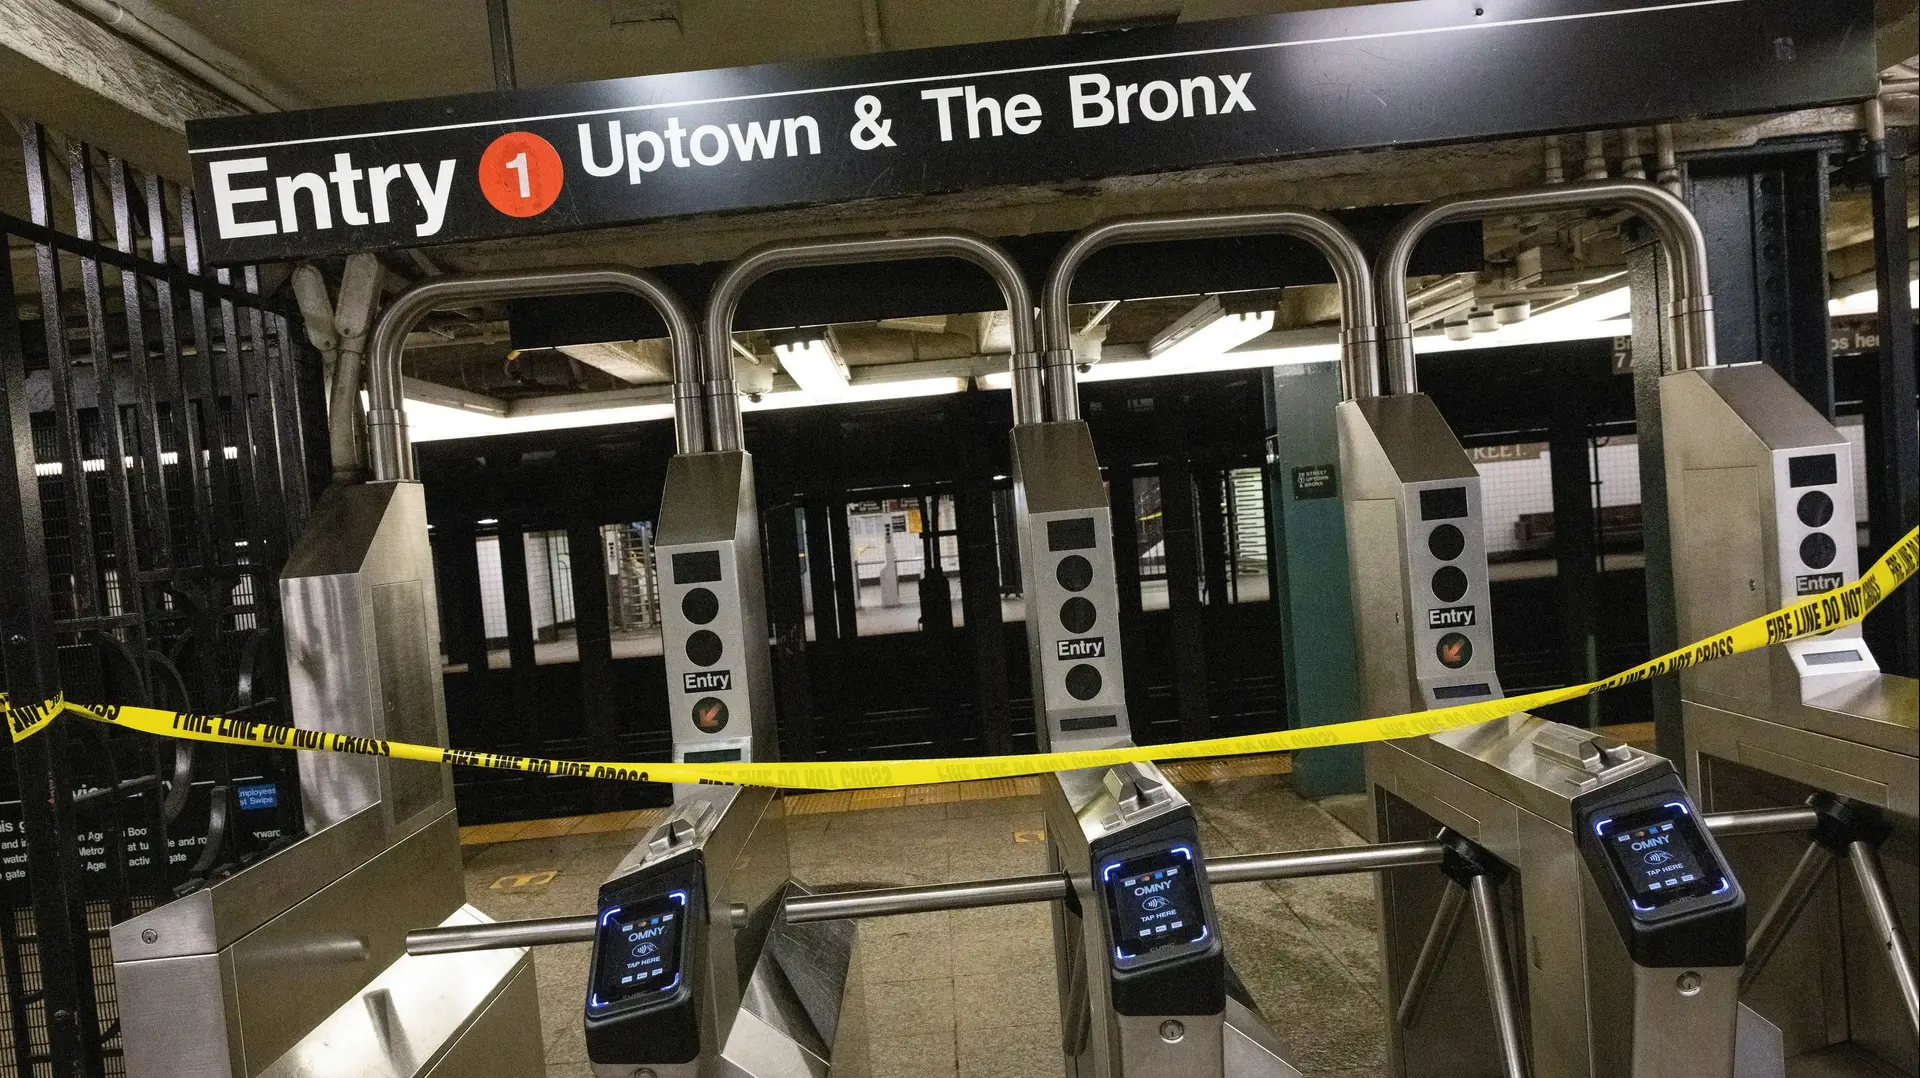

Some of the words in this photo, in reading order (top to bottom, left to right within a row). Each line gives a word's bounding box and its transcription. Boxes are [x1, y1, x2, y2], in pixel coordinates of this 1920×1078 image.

[209, 151, 457, 239] Entry
[505, 152, 532, 198] 1
[577, 114, 822, 185] Uptown
[849, 94, 898, 151] &
[921, 86, 1043, 142] The
[1068, 72, 1257, 129] Bronx
[1797, 574, 1841, 591] Entry
[1430, 609, 1473, 625] Entry
[1766, 613, 1792, 645] FIRE
[1794, 602, 1822, 635] LINE
[1822, 596, 1841, 627] DO
[1840, 586, 1864, 621] NOT
[1059, 640, 1102, 657] Entry
[1649, 662, 1665, 677] DO
[1668, 653, 1692, 673] NOT
[1695, 635, 1734, 664] CROSS
[685, 673, 729, 690] Entry
[172, 711, 213, 735] FIRE
[217, 716, 258, 742] LINE
[262, 724, 291, 745] DO
[293, 728, 327, 750] NOT
[332, 734, 390, 757] CROSS
[442, 749, 479, 765] FIRE
[485, 753, 523, 770] LINE
[528, 758, 551, 773] DO
[556, 761, 591, 777] NOT
[594, 765, 649, 782] CROSS
[238, 788, 276, 798] mployees
[250, 796, 274, 805] Swipe
[1, 839, 19, 850] and
[127, 827, 147, 837] Boo
[79, 846, 104, 857] Metro
[127, 842, 137, 852] at
[178, 836, 195, 847] and
[1631, 834, 1669, 852] OMNY
[5, 869, 26, 881] gate
[129, 856, 150, 867] activ
[1646, 868, 1661, 877] TAP
[1662, 863, 1684, 873] HERE
[1134, 880, 1172, 896] OMNY
[1141, 915, 1155, 923] TAP
[1156, 909, 1177, 919] HERE
[628, 926, 665, 942] OMNY
[626, 961, 641, 969] TAP
[641, 956, 661, 966] HERE
